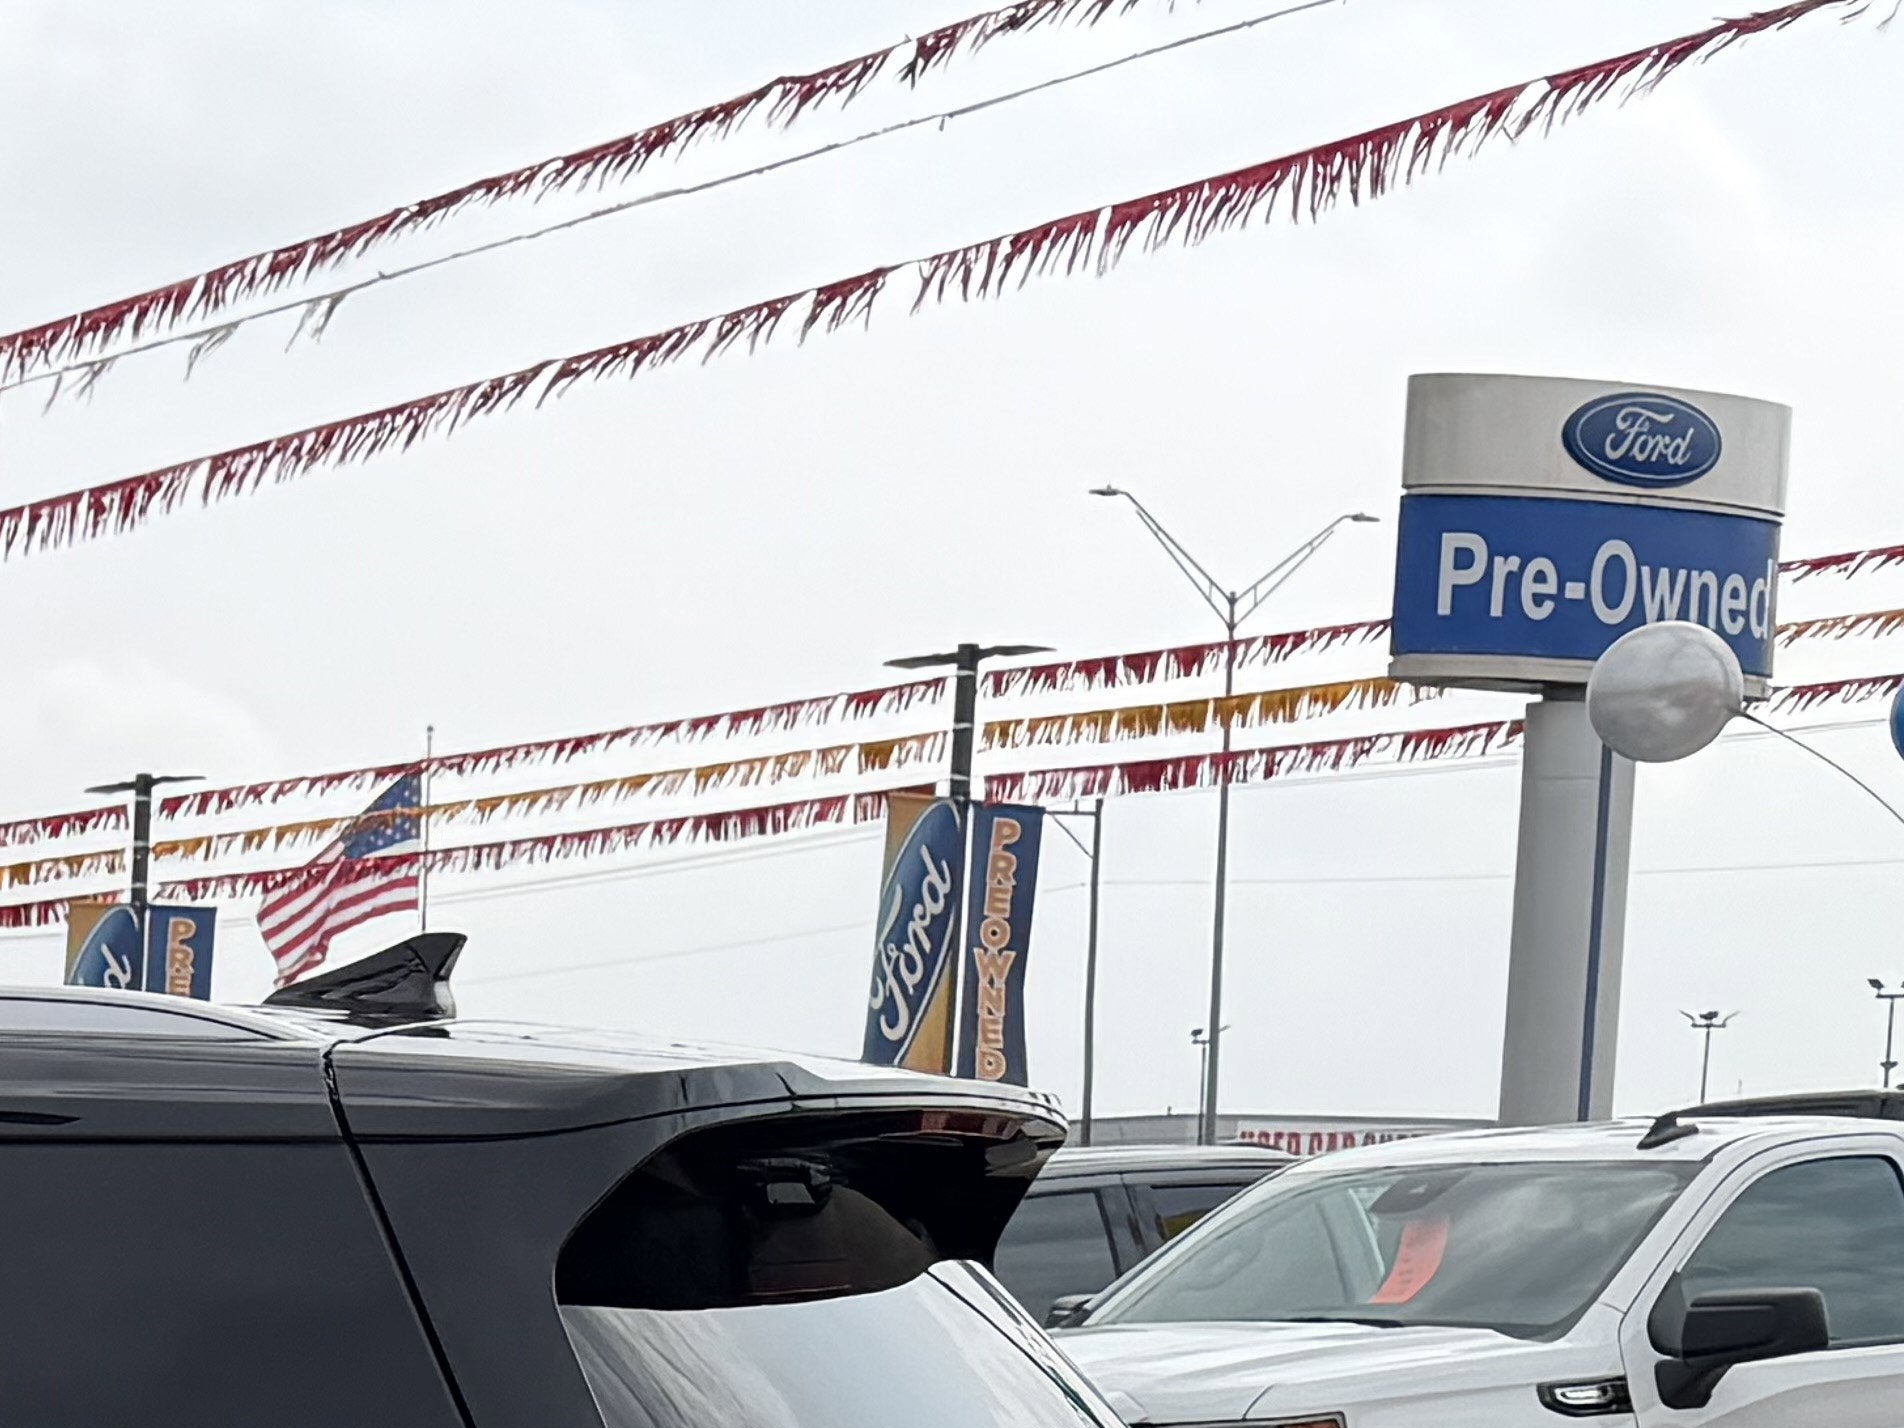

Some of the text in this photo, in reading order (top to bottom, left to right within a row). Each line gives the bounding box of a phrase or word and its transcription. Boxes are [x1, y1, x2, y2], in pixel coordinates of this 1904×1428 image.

[1603, 405, 1696, 468] Ford
[1437, 531, 1775, 640] Pre-Owned
[869, 844, 953, 1042] Ford
